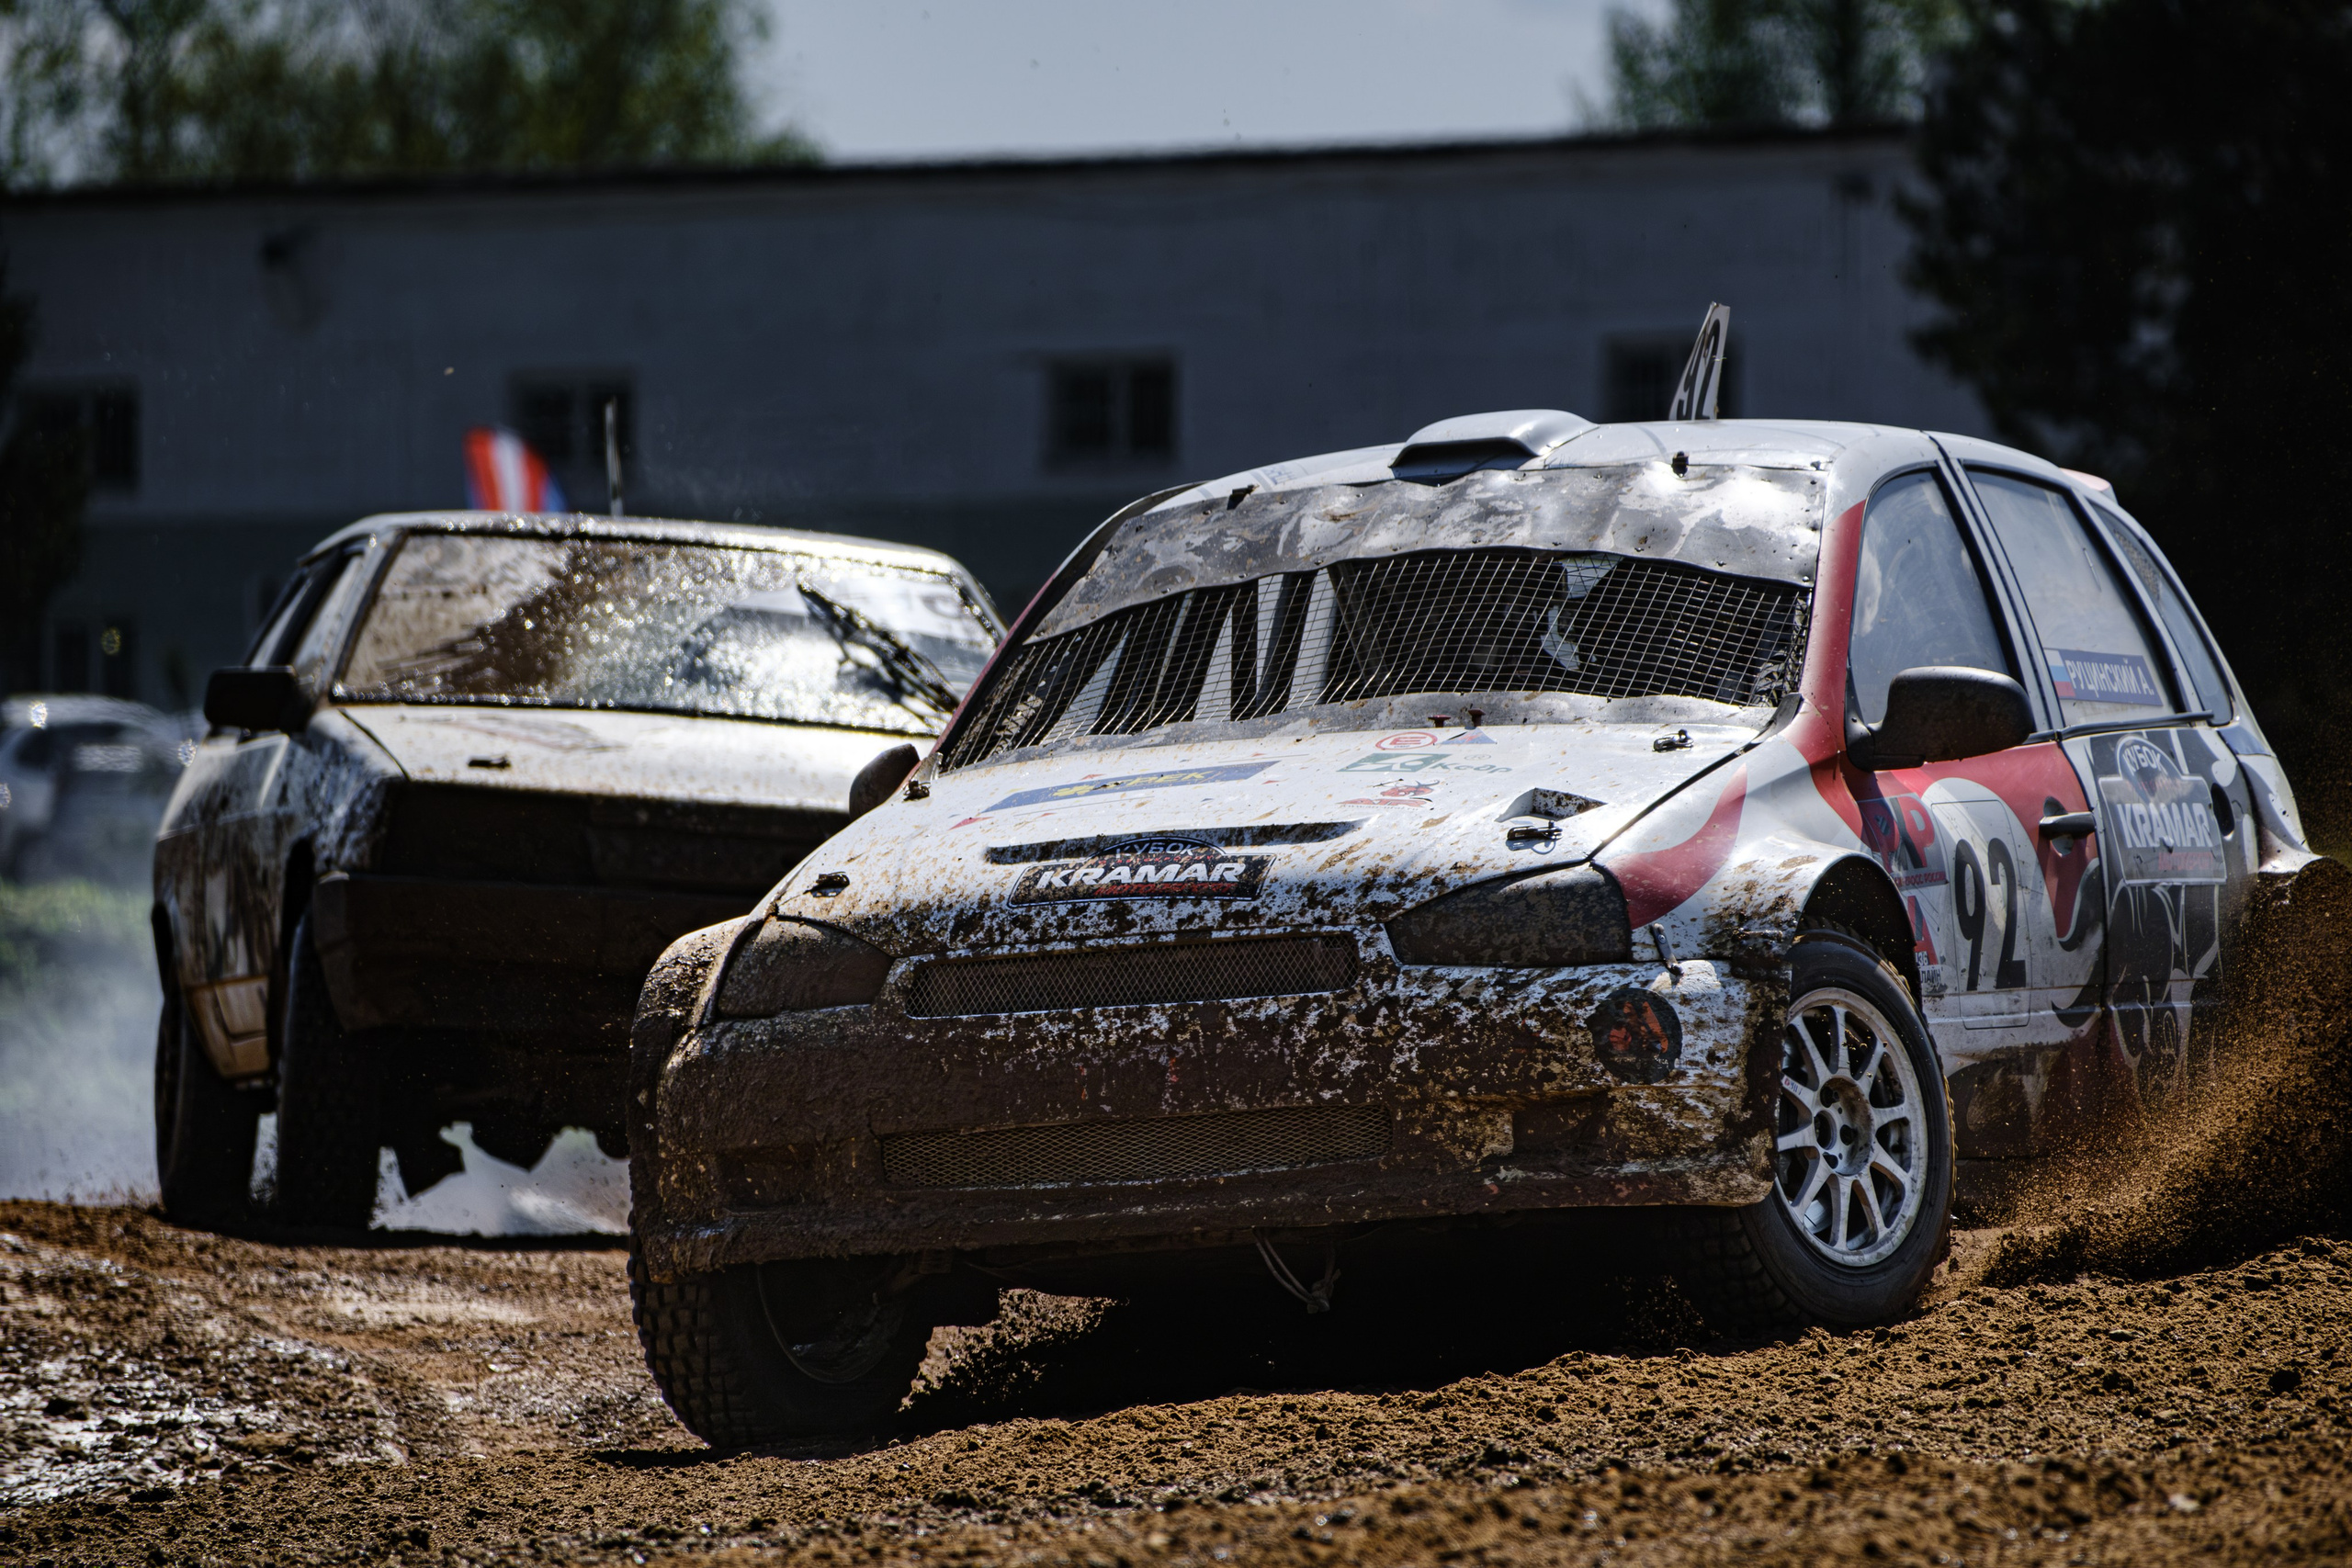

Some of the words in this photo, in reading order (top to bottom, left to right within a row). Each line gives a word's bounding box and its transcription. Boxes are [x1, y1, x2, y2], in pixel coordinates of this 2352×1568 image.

[2064, 658, 2142, 698] РУЦИНСКИЙ
[2122, 744, 2168, 776] КУБОК
[2117, 802, 2213, 849] KRAMAR
[1115, 841, 1200, 859] КУБОК
[1036, 863, 1247, 889] KRAMAR
[1955, 838, 2027, 991] 92
